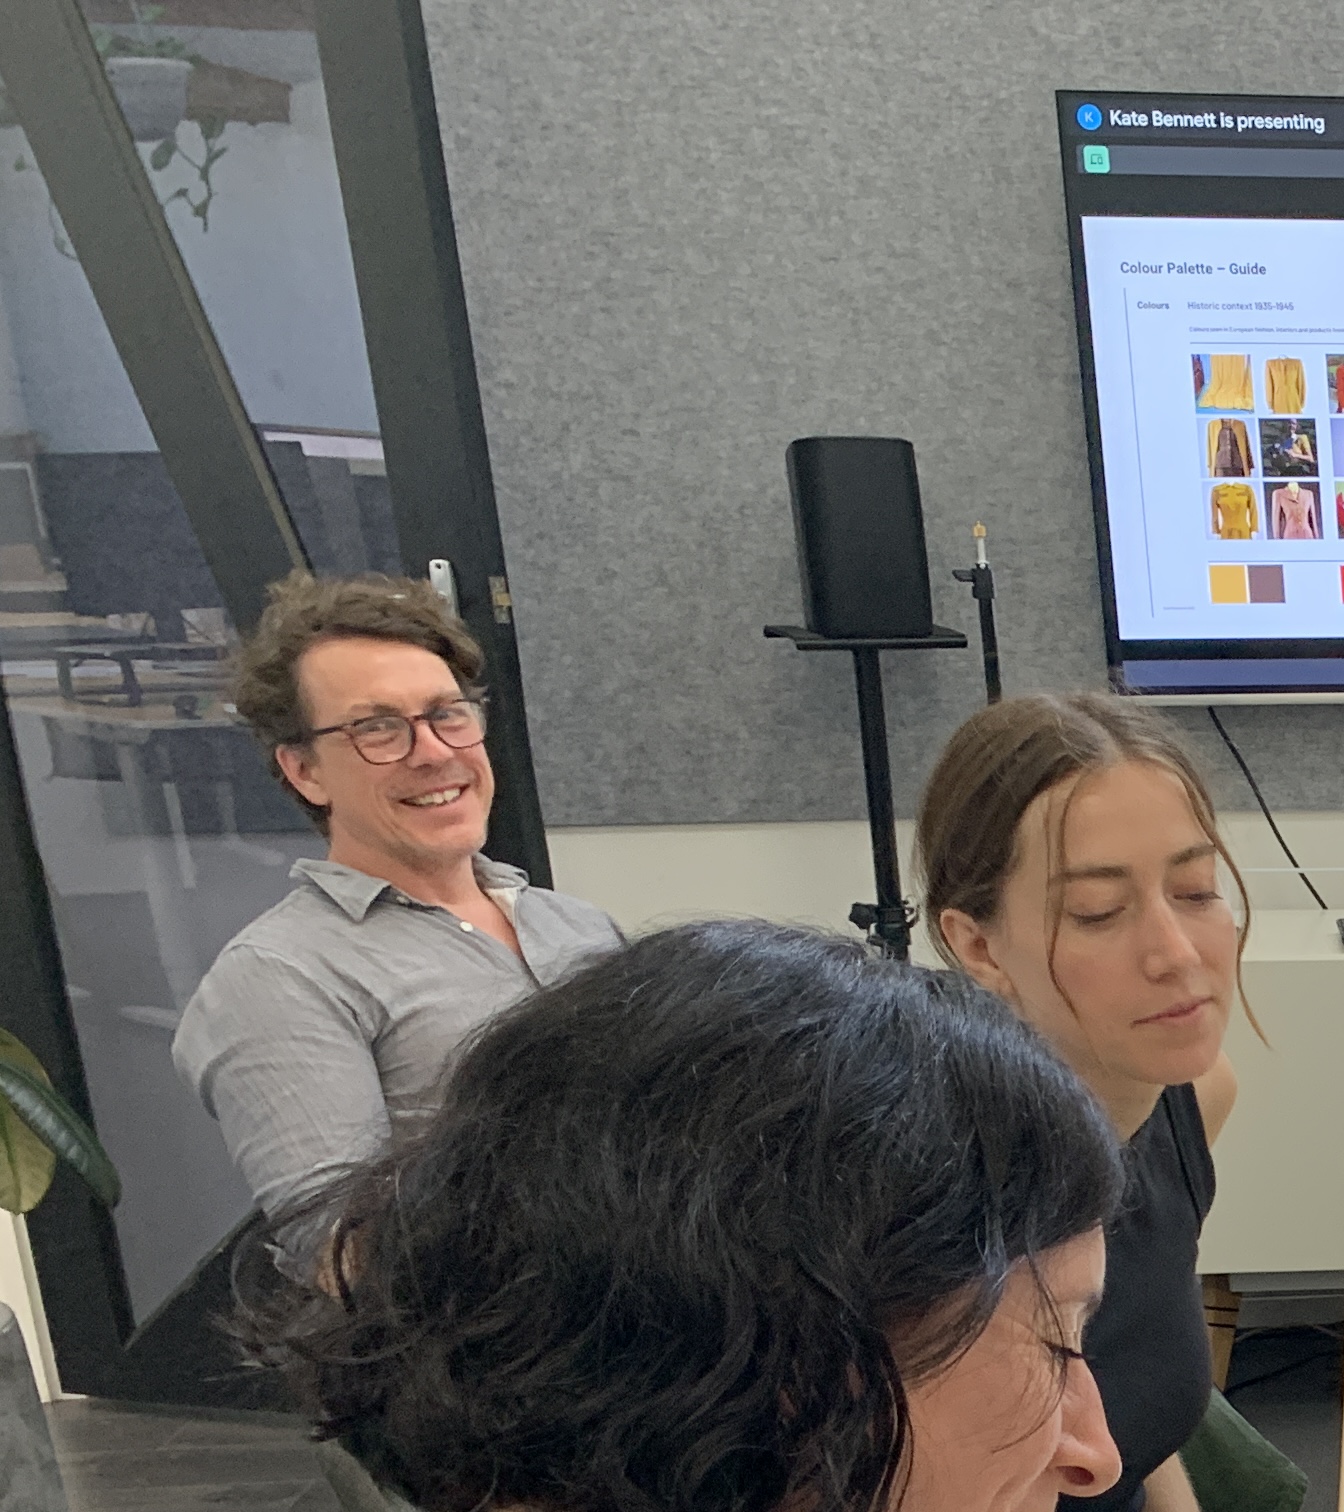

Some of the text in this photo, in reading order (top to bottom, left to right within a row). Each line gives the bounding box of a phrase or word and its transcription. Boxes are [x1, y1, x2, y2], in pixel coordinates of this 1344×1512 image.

[1109, 110, 1326, 134] Kate Bennett is presenting
[1120, 262, 1163, 275] Colour
[1167, 262, 1213, 275] Palette
[1229, 262, 1267, 275] Guide
[1137, 301, 1170, 310] Colours
[1187, 301, 1220, 311] Historic
[1221, 302, 1253, 311] context
